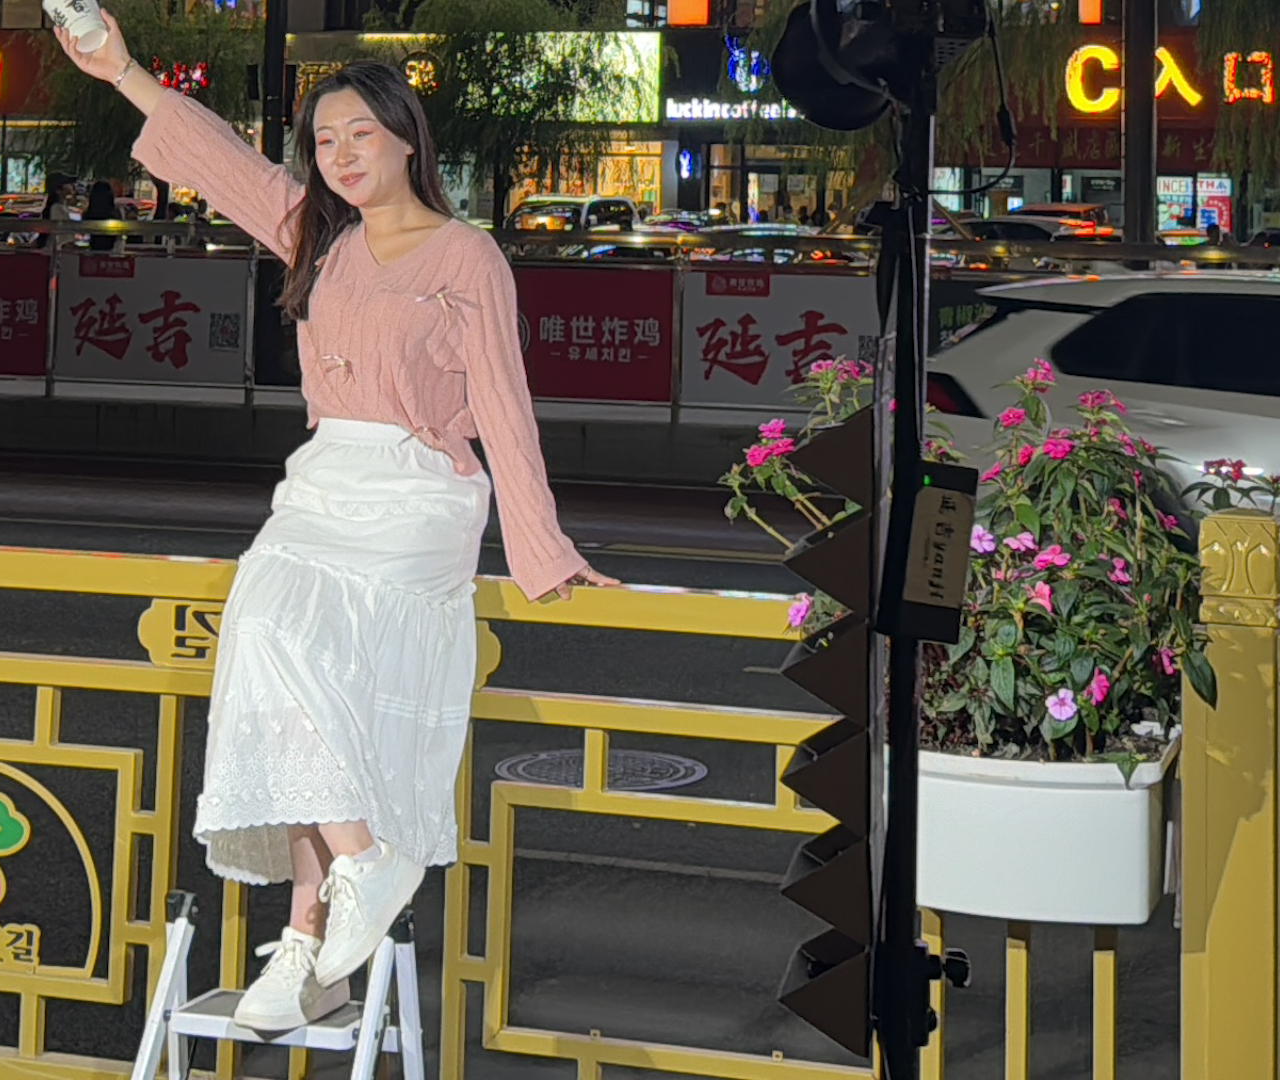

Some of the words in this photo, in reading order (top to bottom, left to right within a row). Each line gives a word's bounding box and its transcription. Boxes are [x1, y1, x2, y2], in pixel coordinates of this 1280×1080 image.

[1064, 43, 1121, 114] C
[1153, 45, 1275, 107] 入口
[69, 290, 201, 370] 延吉
[538, 315, 662, 349] 唯世炸鸡
